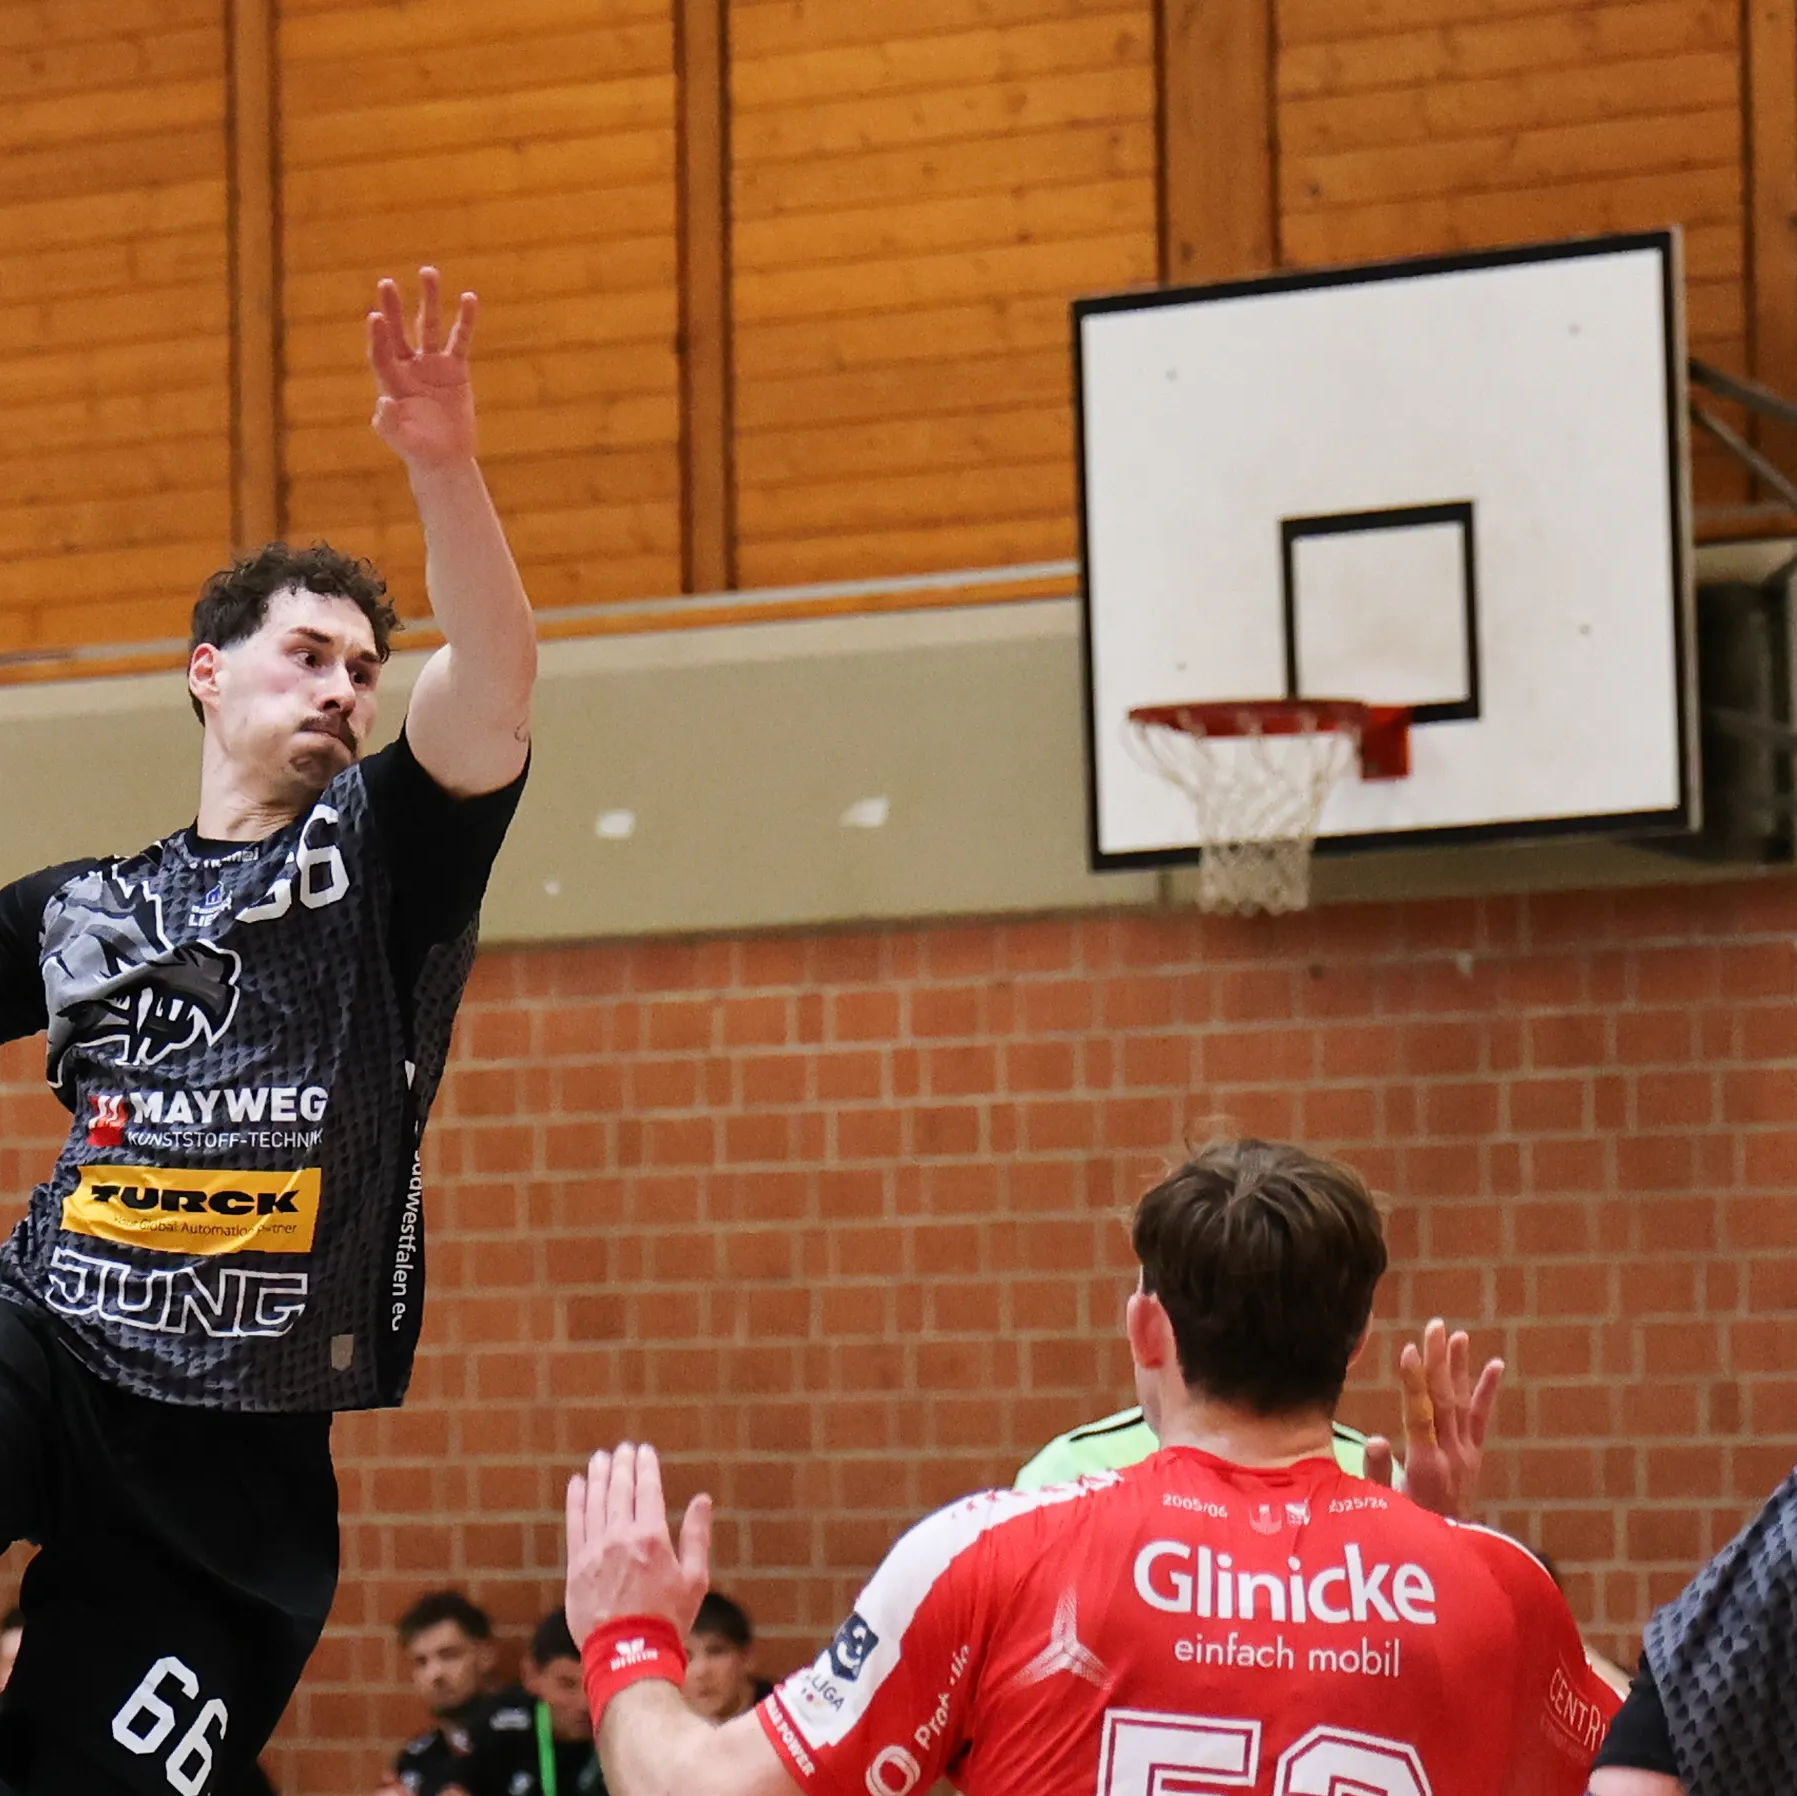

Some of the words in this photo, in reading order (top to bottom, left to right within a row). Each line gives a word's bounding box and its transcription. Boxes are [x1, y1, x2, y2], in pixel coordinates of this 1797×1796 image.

[130, 1085, 329, 1124] MAYWEG
[127, 1128, 324, 1149] KUNSTSTOFF-TECHNIK
[91, 1184, 300, 1216] TURCK
[45, 1246, 308, 1337] JUNG
[1133, 1539, 1437, 1625] Glinicke
[1174, 1632, 1294, 1670] einfach
[1308, 1636, 1401, 1679] mobil
